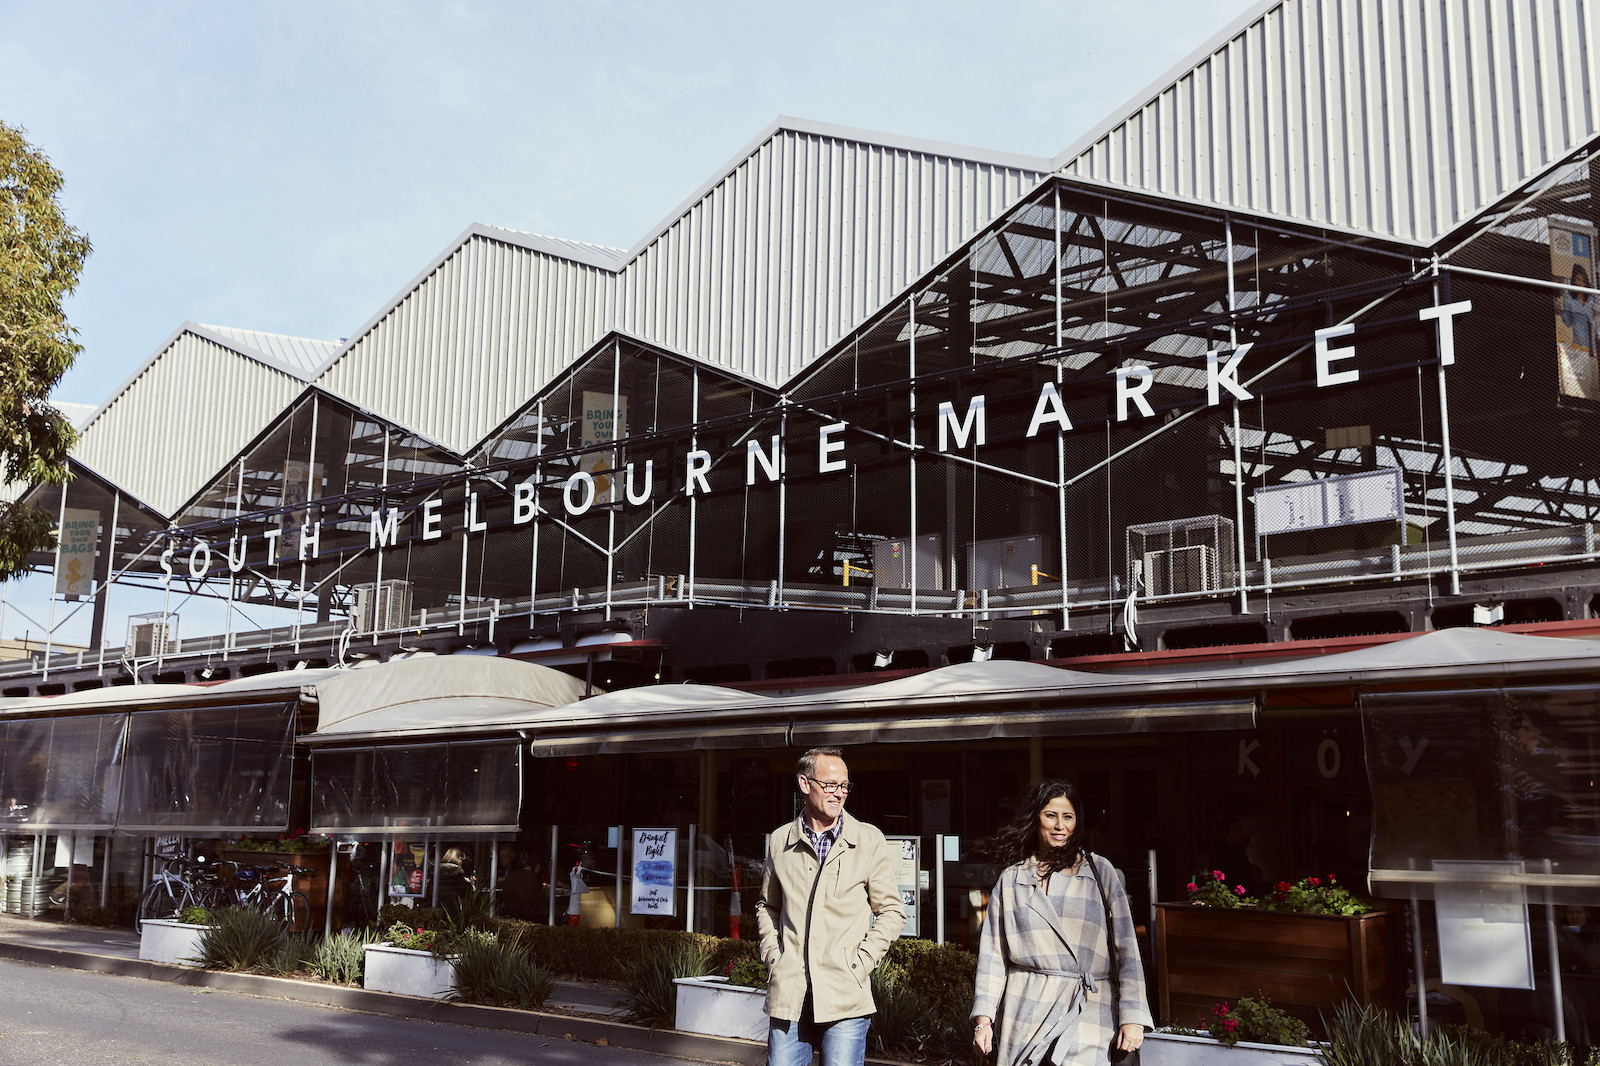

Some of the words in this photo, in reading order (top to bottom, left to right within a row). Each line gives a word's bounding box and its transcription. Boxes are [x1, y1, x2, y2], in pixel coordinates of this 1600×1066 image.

[158, 522, 320, 585] SOUTH
[369, 422, 848, 550] MELBOURNE
[938, 300, 1472, 452] MARKET
[64, 520, 95, 530] BRING
[69, 529, 91, 537] YOUR
[61, 543, 94, 554] BAGS
[639, 831, 670, 846] Banquet
[645, 844, 666, 859] Night
